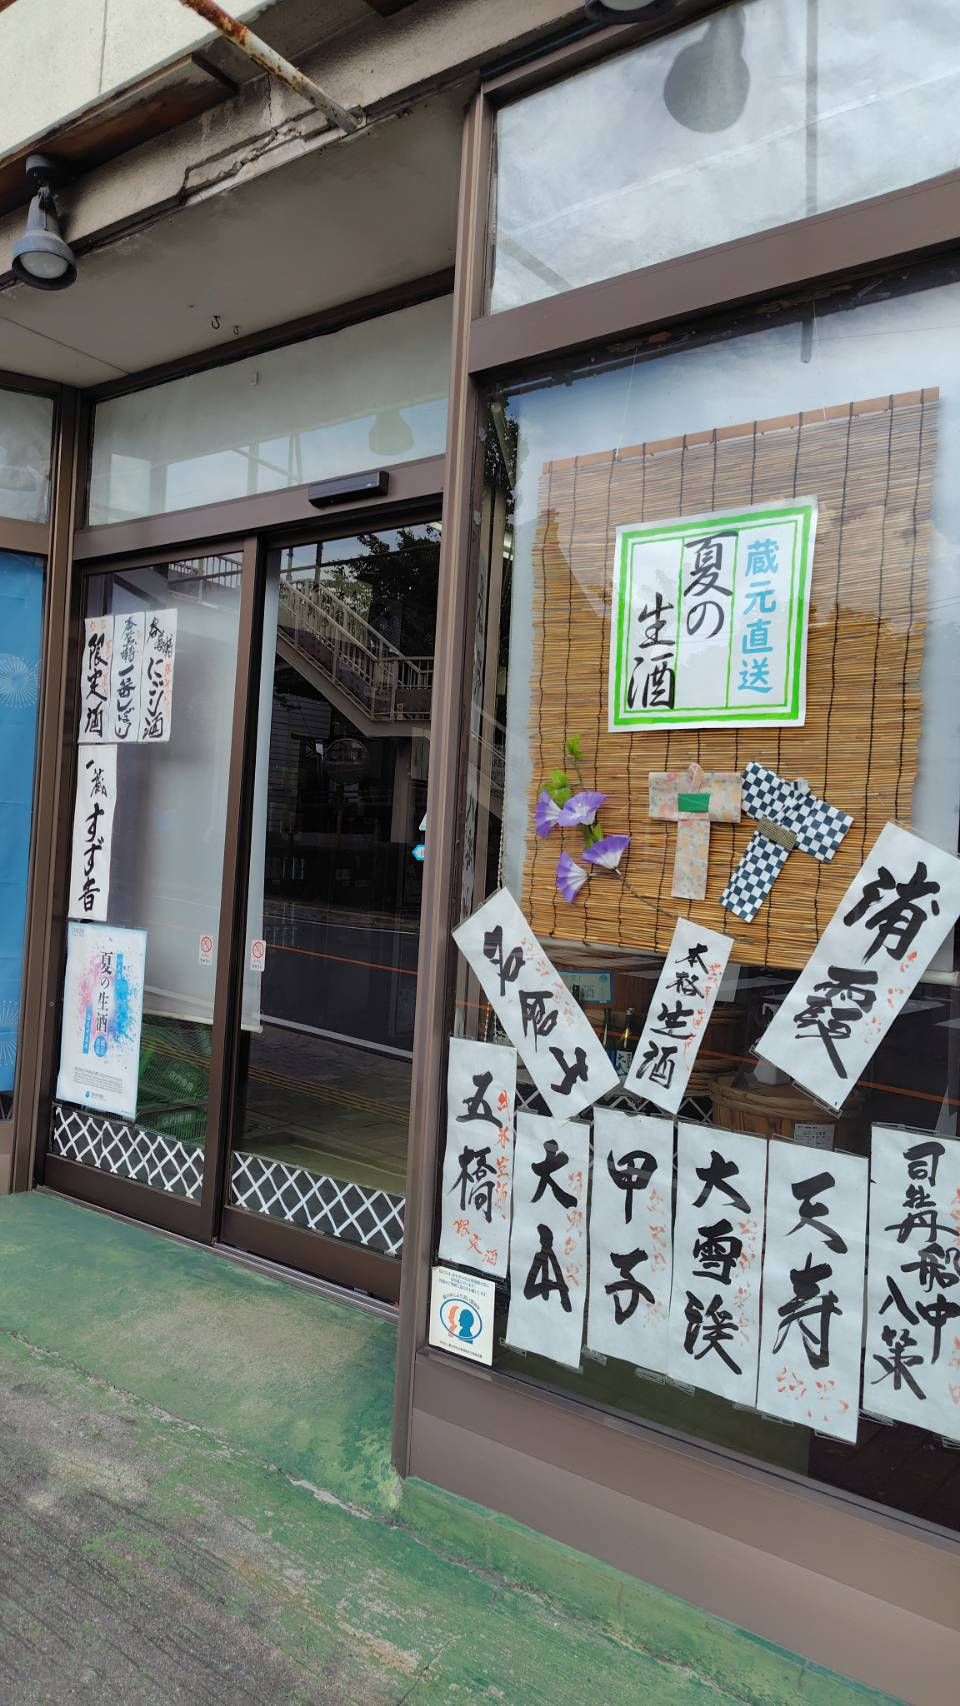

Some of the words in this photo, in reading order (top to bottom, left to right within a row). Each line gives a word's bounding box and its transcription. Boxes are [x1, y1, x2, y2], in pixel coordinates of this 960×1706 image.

[627, 592, 676, 711] 生酒
[683, 531, 739, 639] 夏の
[737, 538, 779, 694] 蔵元直送
[85, 633, 108, 737] 限定酒
[97, 951, 113, 1033] 夏の生酒
[483, 925, 588, 1095] 名倉山
[635, 943, 709, 1090] 本格生酒
[793, 861, 941, 1079] 浦霞
[448, 1071, 503, 1223] 五橋
[523, 1139, 578, 1312] 大山
[605, 1148, 658, 1325] 甲子
[684, 1150, 751, 1375] 大雪渓
[773, 1171, 848, 1369] 天寿
